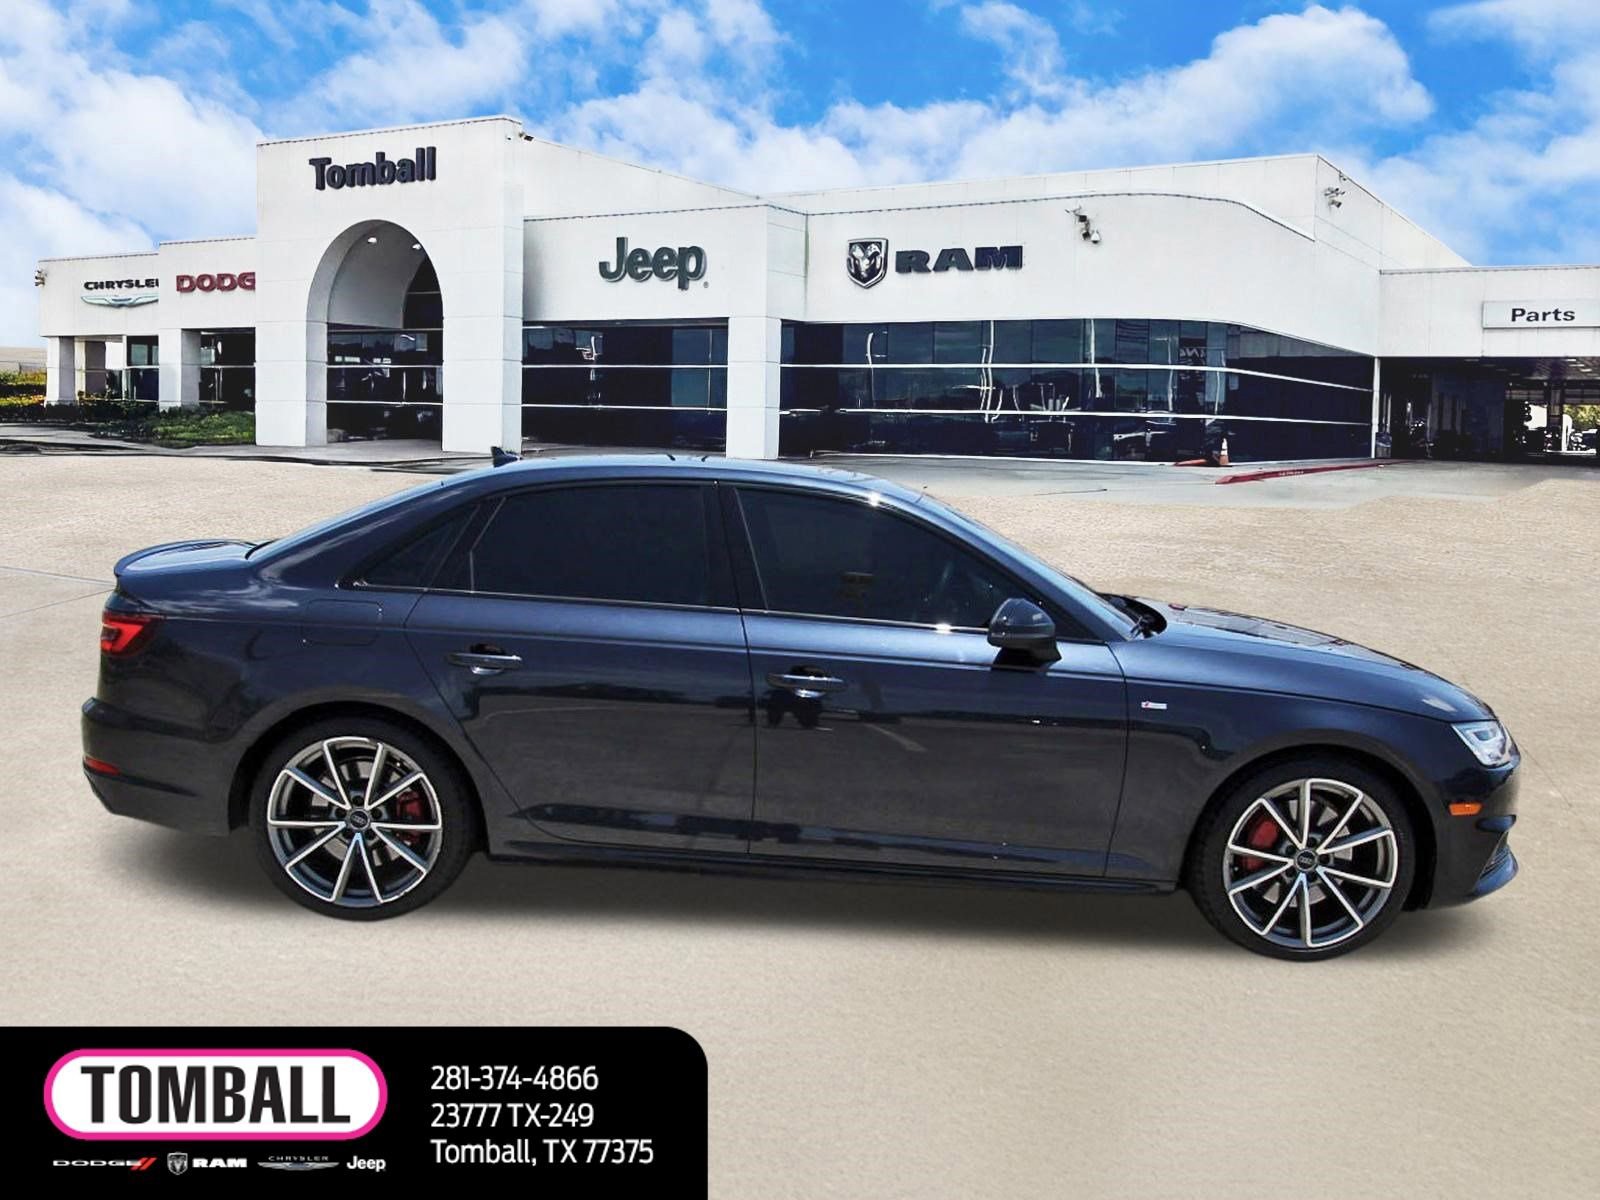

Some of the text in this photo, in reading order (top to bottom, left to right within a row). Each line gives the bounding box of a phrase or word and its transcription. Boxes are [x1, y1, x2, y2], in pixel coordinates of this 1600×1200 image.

[309, 146, 436, 191] Tomball
[599, 237, 707, 291] Jeep
[896, 246, 1023, 274] RAM
[176, 272, 255, 293] DODG
[1511, 308, 1575, 322] Parts
